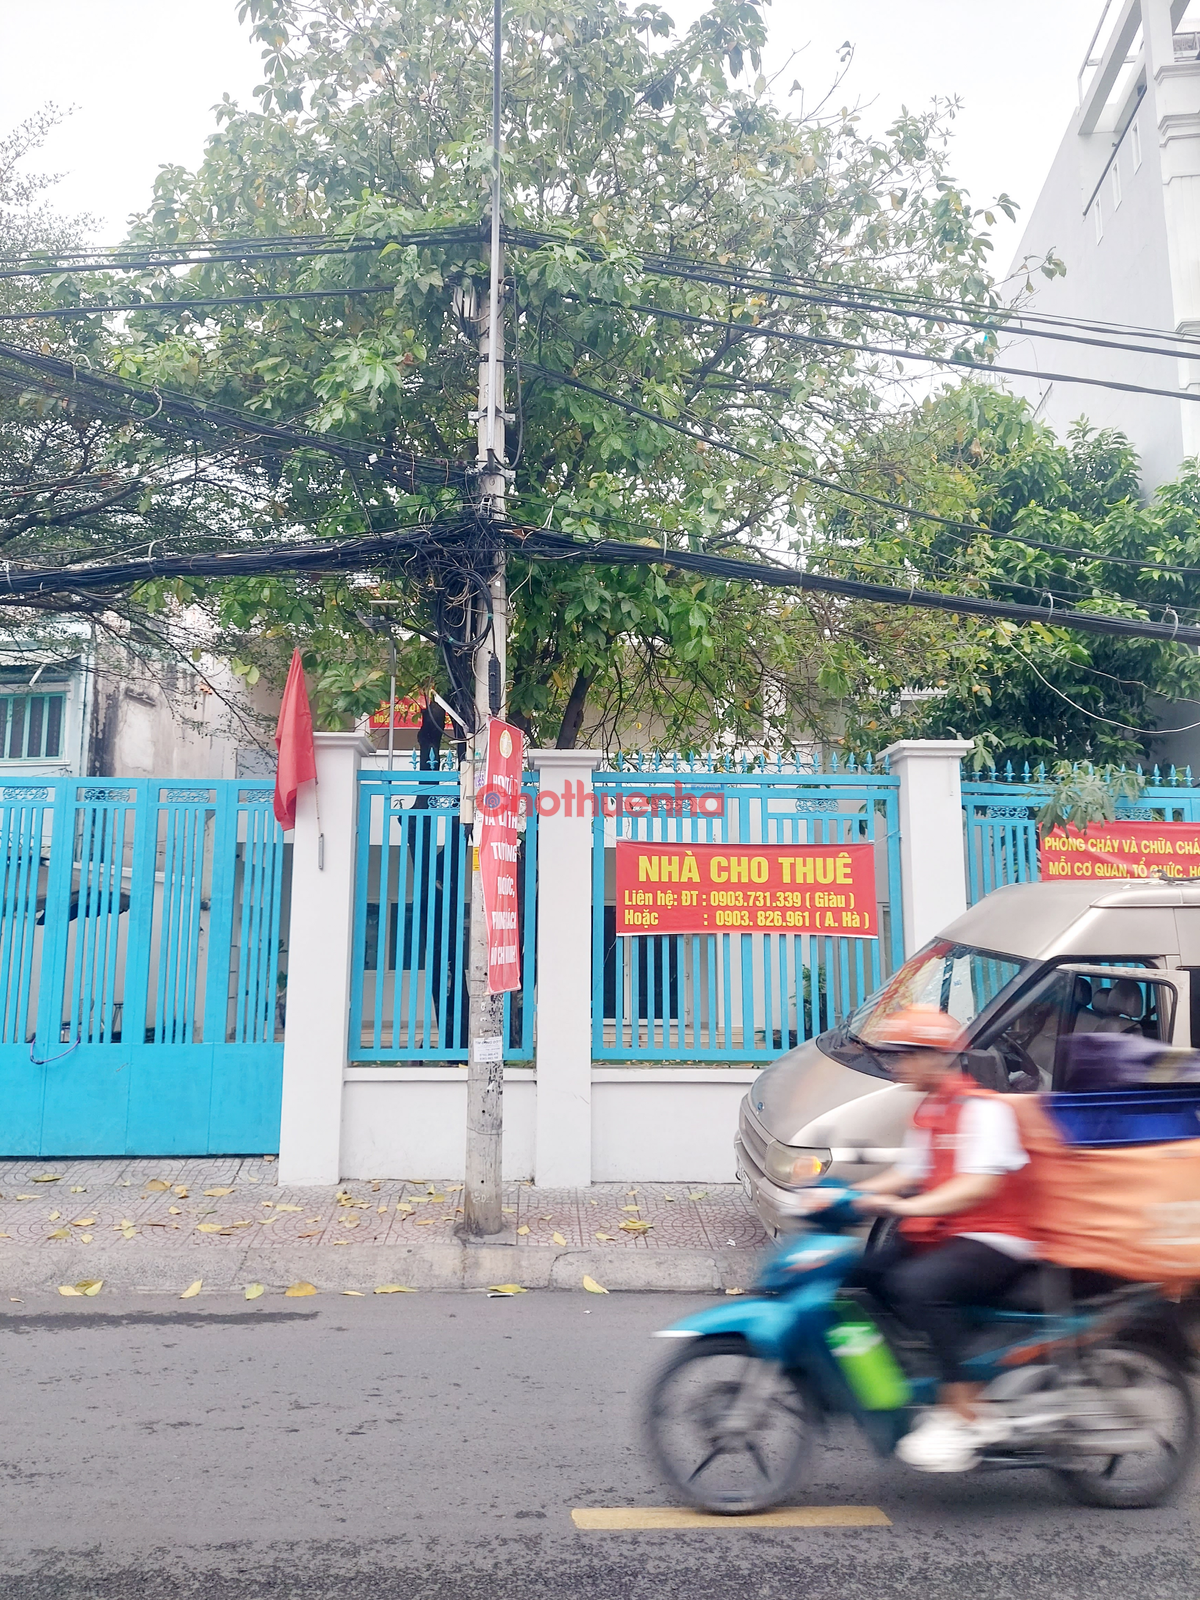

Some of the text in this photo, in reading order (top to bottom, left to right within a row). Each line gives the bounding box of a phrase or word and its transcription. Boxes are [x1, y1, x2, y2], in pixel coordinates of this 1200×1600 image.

[1044, 834, 1200, 855] PHÒNG CHÁY VÀ CHỮA CHÁ
[638, 850, 853, 884] NHÀ CHO THUÊ
[1048, 855, 1072, 876] MỖI
[1073, 860, 1092, 877] CƠ
[1094, 862, 1131, 880] QUAN,
[1132, 857, 1148, 878] TỔ
[624, 889, 653, 906] Liên
[656, 889, 678, 909] hệ:
[681, 890, 699, 906] ĐT
[710, 890, 802, 908] 0903.731.339
[624, 908, 659, 929] Hoặc
